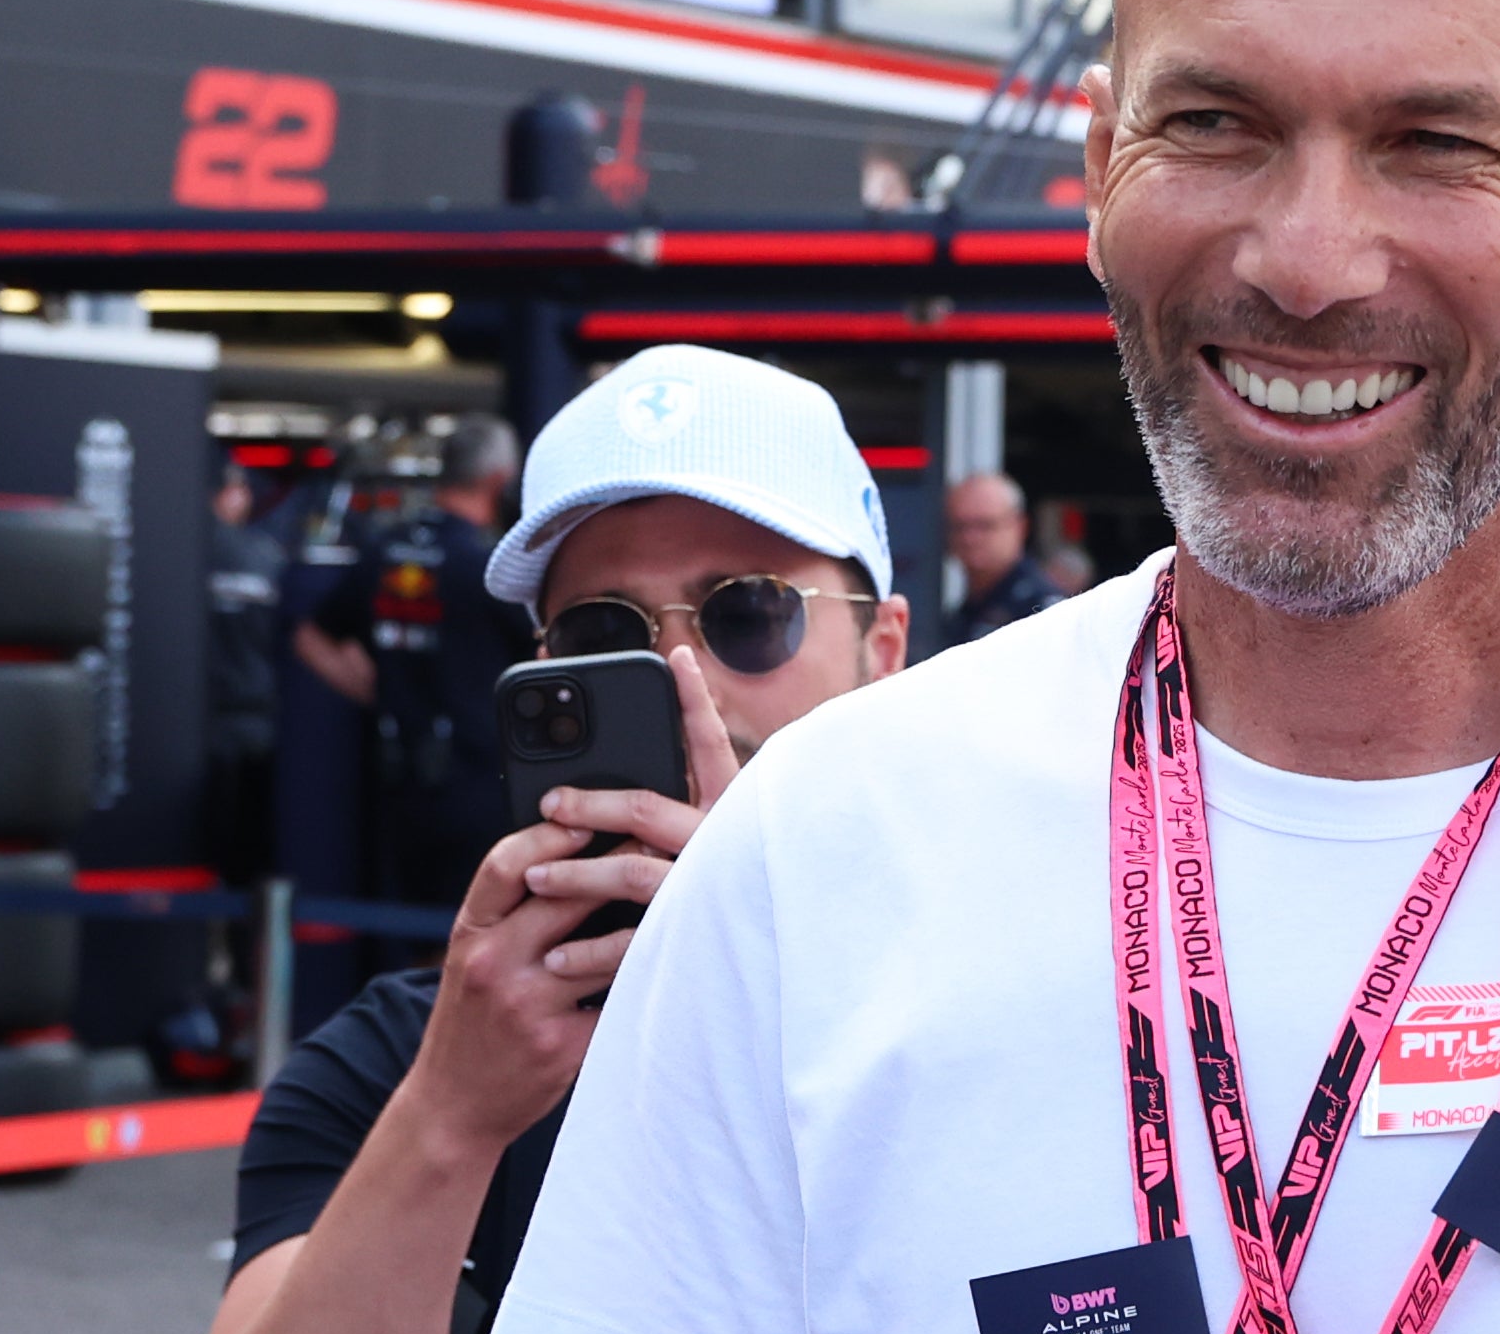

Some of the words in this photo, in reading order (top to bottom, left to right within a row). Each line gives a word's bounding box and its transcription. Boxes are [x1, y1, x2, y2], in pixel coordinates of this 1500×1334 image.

[173, 67, 338, 212] 22
[1156, 619, 1178, 670] VIP
[1136, 742, 1147, 772] 2025
[1175, 724, 1187, 756] 2025
[1117, 776, 1148, 822] Carlo
[1166, 758, 1197, 810] Carlo
[1120, 820, 1150, 866] Monte
[1172, 806, 1199, 855] Monte
[1125, 870, 1150, 992] MONACO
[1180, 858, 1213, 977] MONACO
[1355, 896, 1434, 1017] MONACO
[1417, 844, 1456, 900] Monte
[1444, 798, 1481, 852] Carlo
[1401, 1030, 1462, 1058] PIT
[1139, 1072, 1167, 1126] Guest
[1209, 1053, 1241, 1107] Guest
[1211, 1105, 1248, 1167] VIP
[1280, 1134, 1326, 1198] VIP
[1312, 1084, 1350, 1143] Guest
[1411, 1104, 1486, 1128] MONACO
[1140, 1121, 1176, 1192] VIP
[1070, 1285, 1118, 1314] BWT
[1400, 1265, 1439, 1334] 75
[1110, 1322, 1132, 1334] TEAM
